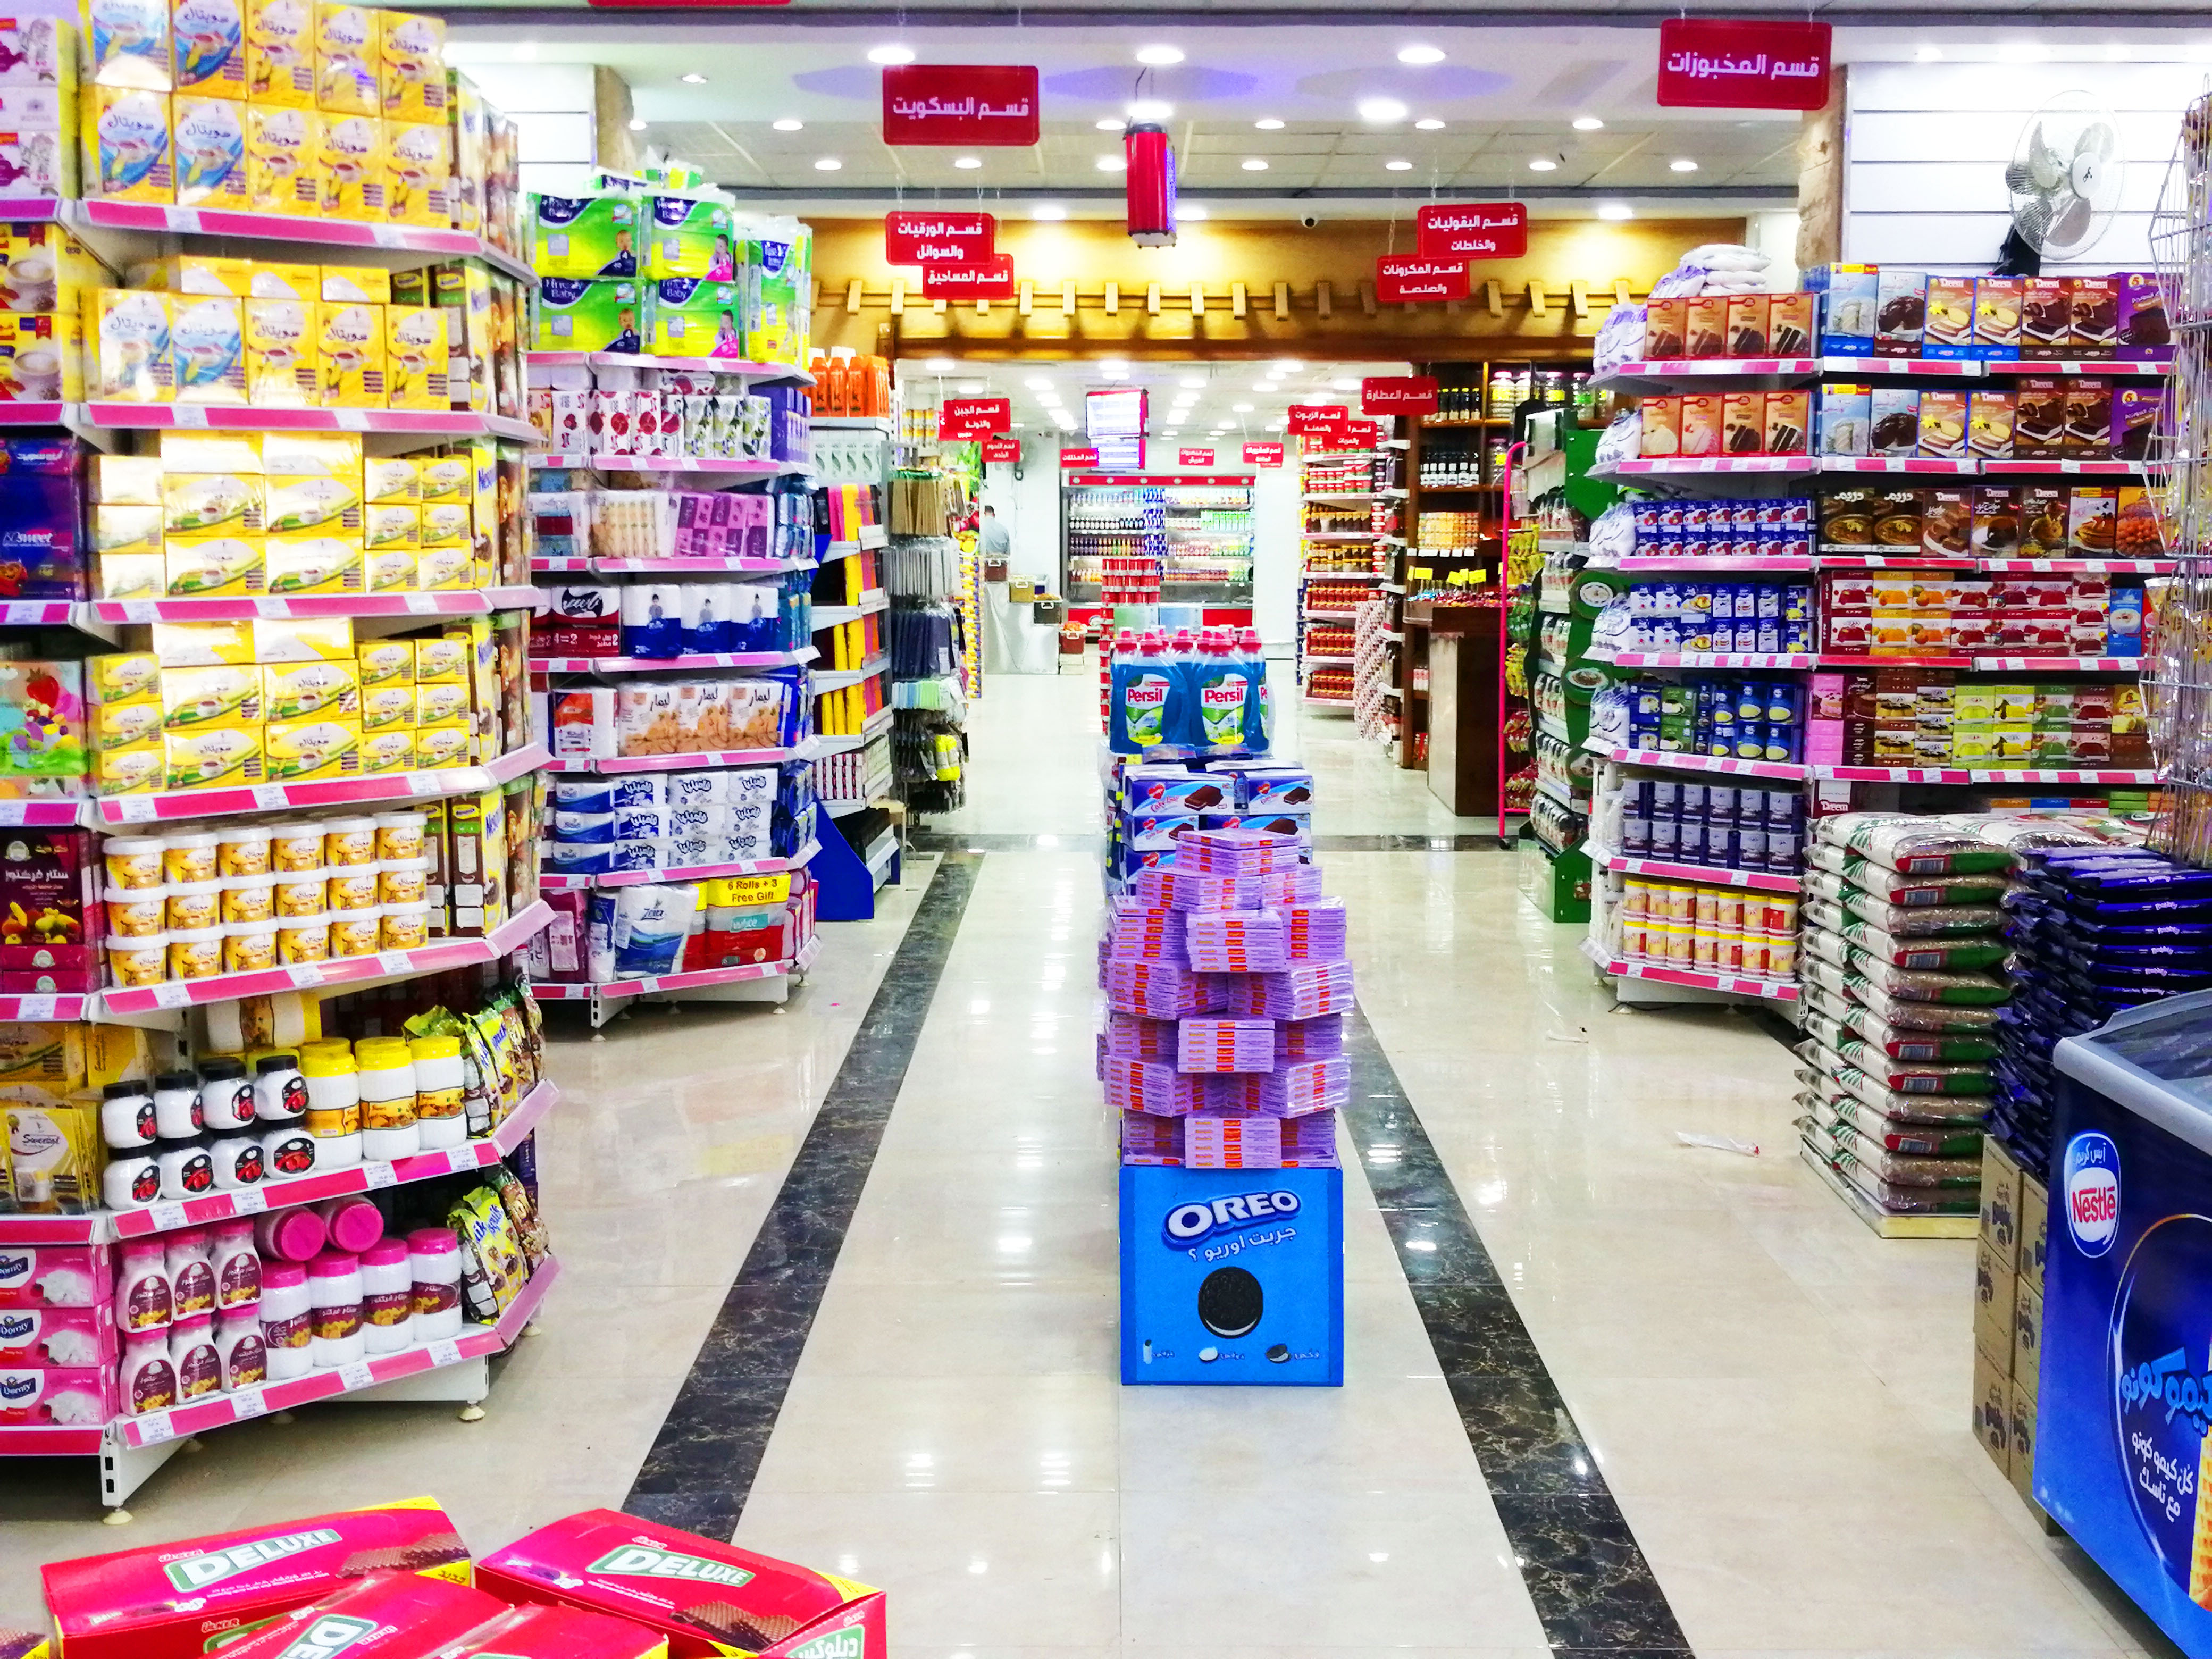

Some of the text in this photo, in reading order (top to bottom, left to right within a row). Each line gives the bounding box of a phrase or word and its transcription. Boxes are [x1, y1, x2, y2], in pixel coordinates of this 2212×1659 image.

[183, 4, 230, 24] سويتال
[1667, 51, 1819, 80] قسم المخبوزات
[893, 96, 1029, 121] قسم البسكويت
[898, 222, 982, 238] قسم الورقيات
[1427, 214, 1518, 232] قسم البقوليات
[1451, 239, 1496, 252] والخلطات
[1382, 262, 1463, 277] قسم المكرونات
[927, 270, 1009, 285] قسم المساحيق
[1398, 283, 1448, 294] والصلصة
[255, 323, 300, 339] سويتال
[325, 327, 368, 341] سويتال
[1365, 389, 1433, 402] قسم العطارة
[975, 404, 1000, 416] قسم
[1295, 410, 1342, 421] قسم الزيوت
[1351, 425, 1371, 433] قسم
[1833, 491, 1864, 503] دريم
[1884, 491, 1914, 503] دريم
[1127, 688, 1163, 702] Persil
[1204, 687, 1244, 703] Persil
[1821, 800, 1849, 812] Dreem
[736, 879, 760, 890] Rolls
[731, 891, 774, 903] Free Gift
[1168, 1192, 1298, 1238] OREO
[1249, 1226, 1297, 1247] جربت
[2132, 1431, 2152, 1463] كونو
[180, 1529, 334, 1586] DELUXE
[604, 1548, 749, 1585] DELUXE
[438, 1570, 466, 1584] جديد
